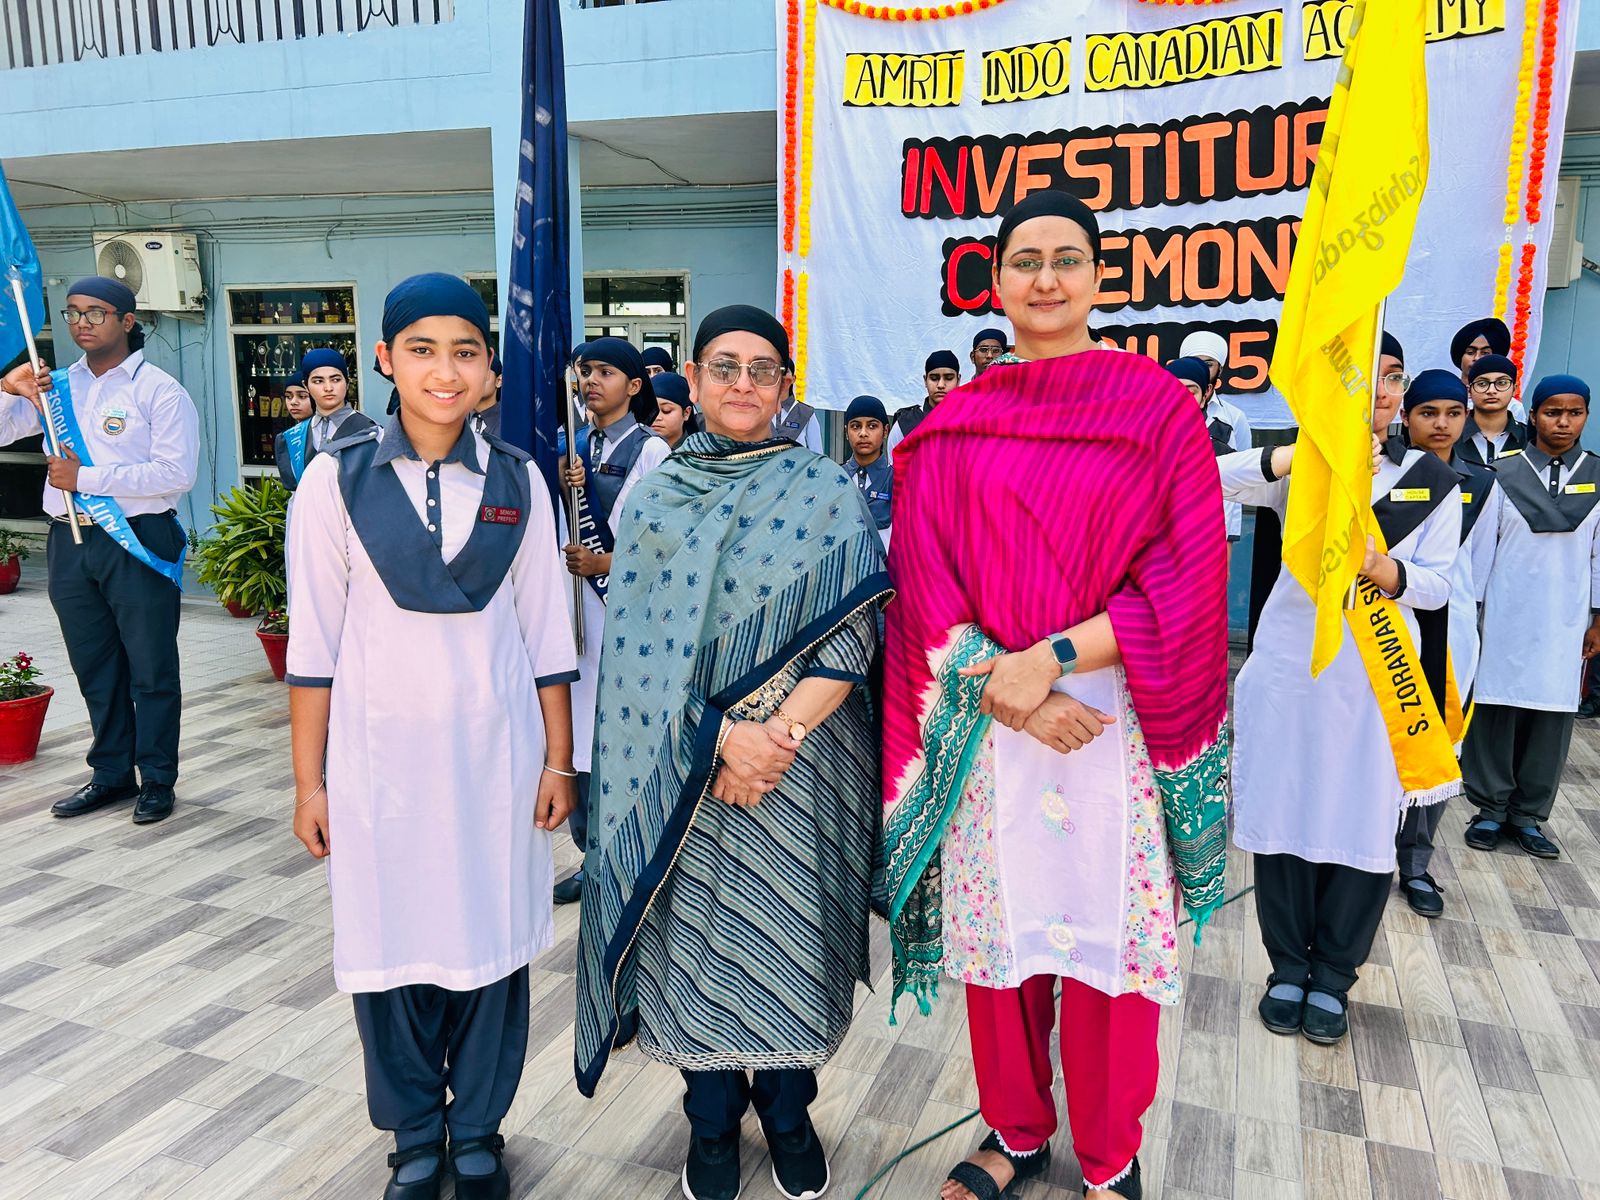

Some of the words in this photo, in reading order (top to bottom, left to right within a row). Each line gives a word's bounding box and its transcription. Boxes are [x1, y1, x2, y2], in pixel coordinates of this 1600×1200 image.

[855, 57, 963, 100] AMRIT
[986, 47, 1064, 97] INDO
[1088, 18, 1276, 84] CANADIAN
[1306, 0, 1487, 54] ACMY
[903, 109, 1329, 215] INVESTITUR
[947, 221, 1302, 310] CEMON
[88, 503, 121, 534] AJIT
[497, 515, 517, 523] PREFECT
[579, 515, 596, 531] JI
[1358, 574, 1383, 607] SIN
[1370, 607, 1422, 713] ZORAWAR
[1407, 713, 1430, 737] S.
